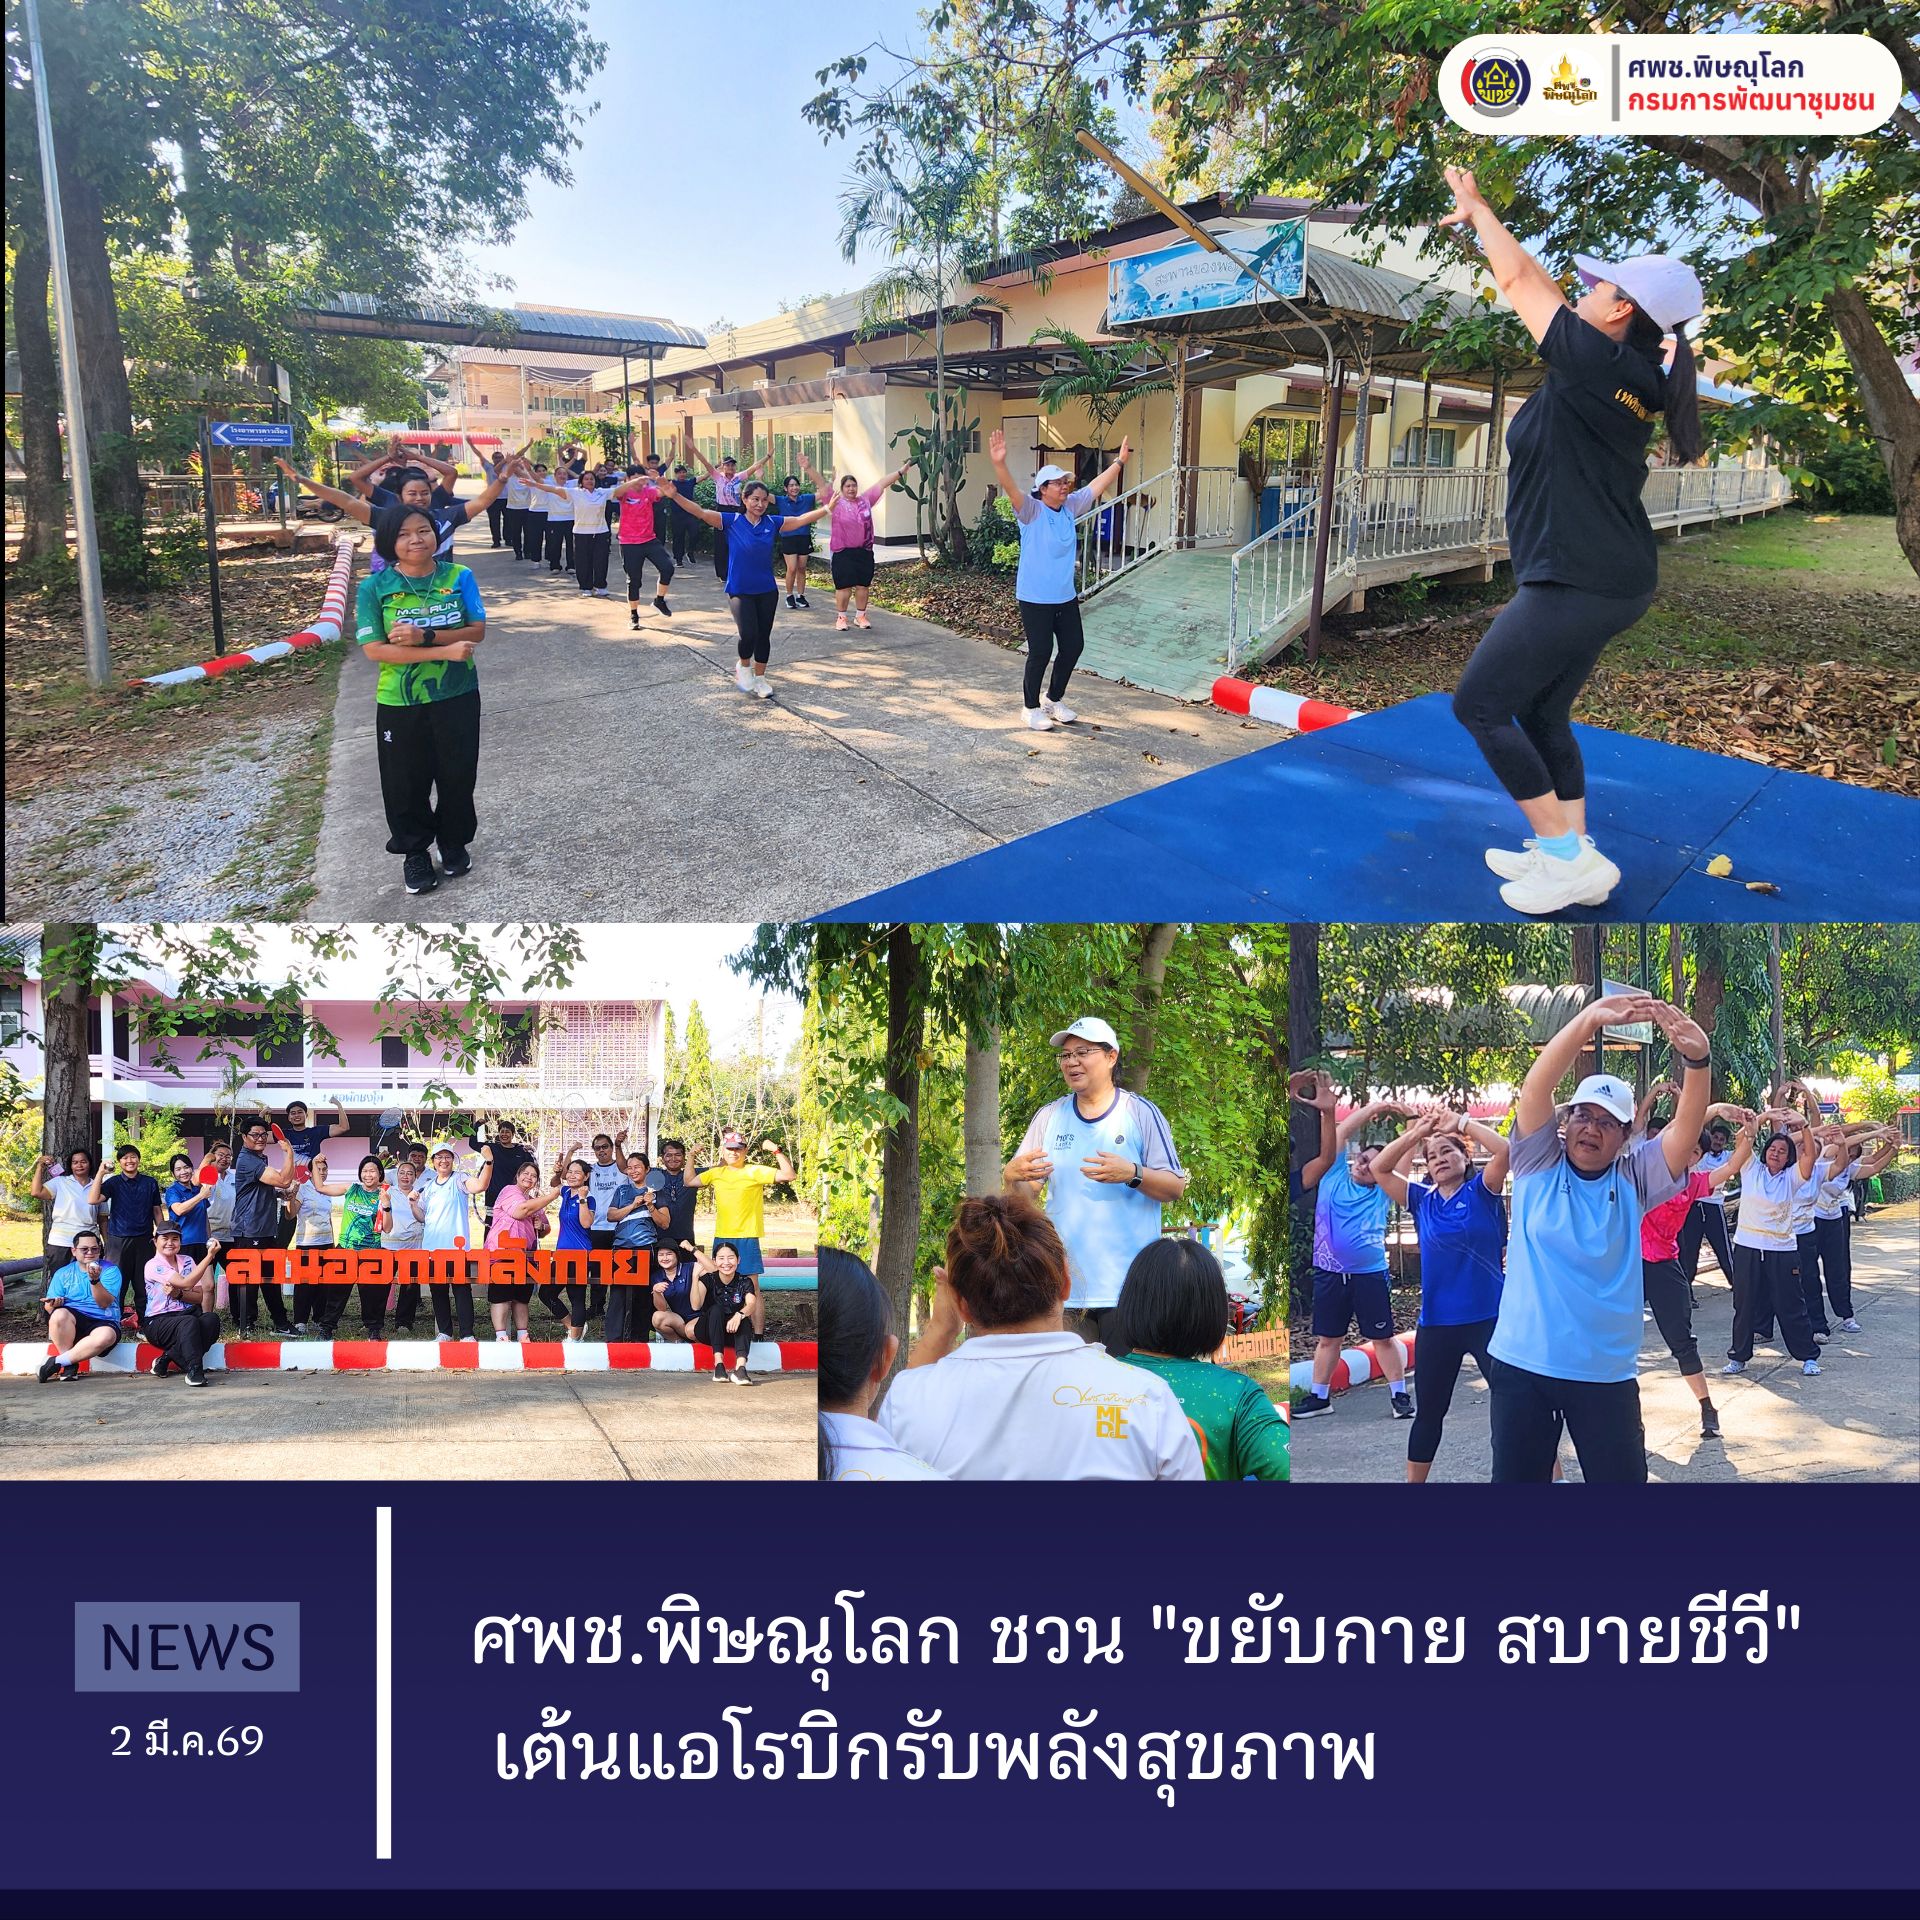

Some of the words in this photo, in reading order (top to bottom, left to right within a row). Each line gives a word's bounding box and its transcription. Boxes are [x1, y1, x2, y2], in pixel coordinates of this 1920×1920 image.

[430, 601, 458, 614] RUN
[226, 1230, 650, 1286] ลานออกกำลังกาย
